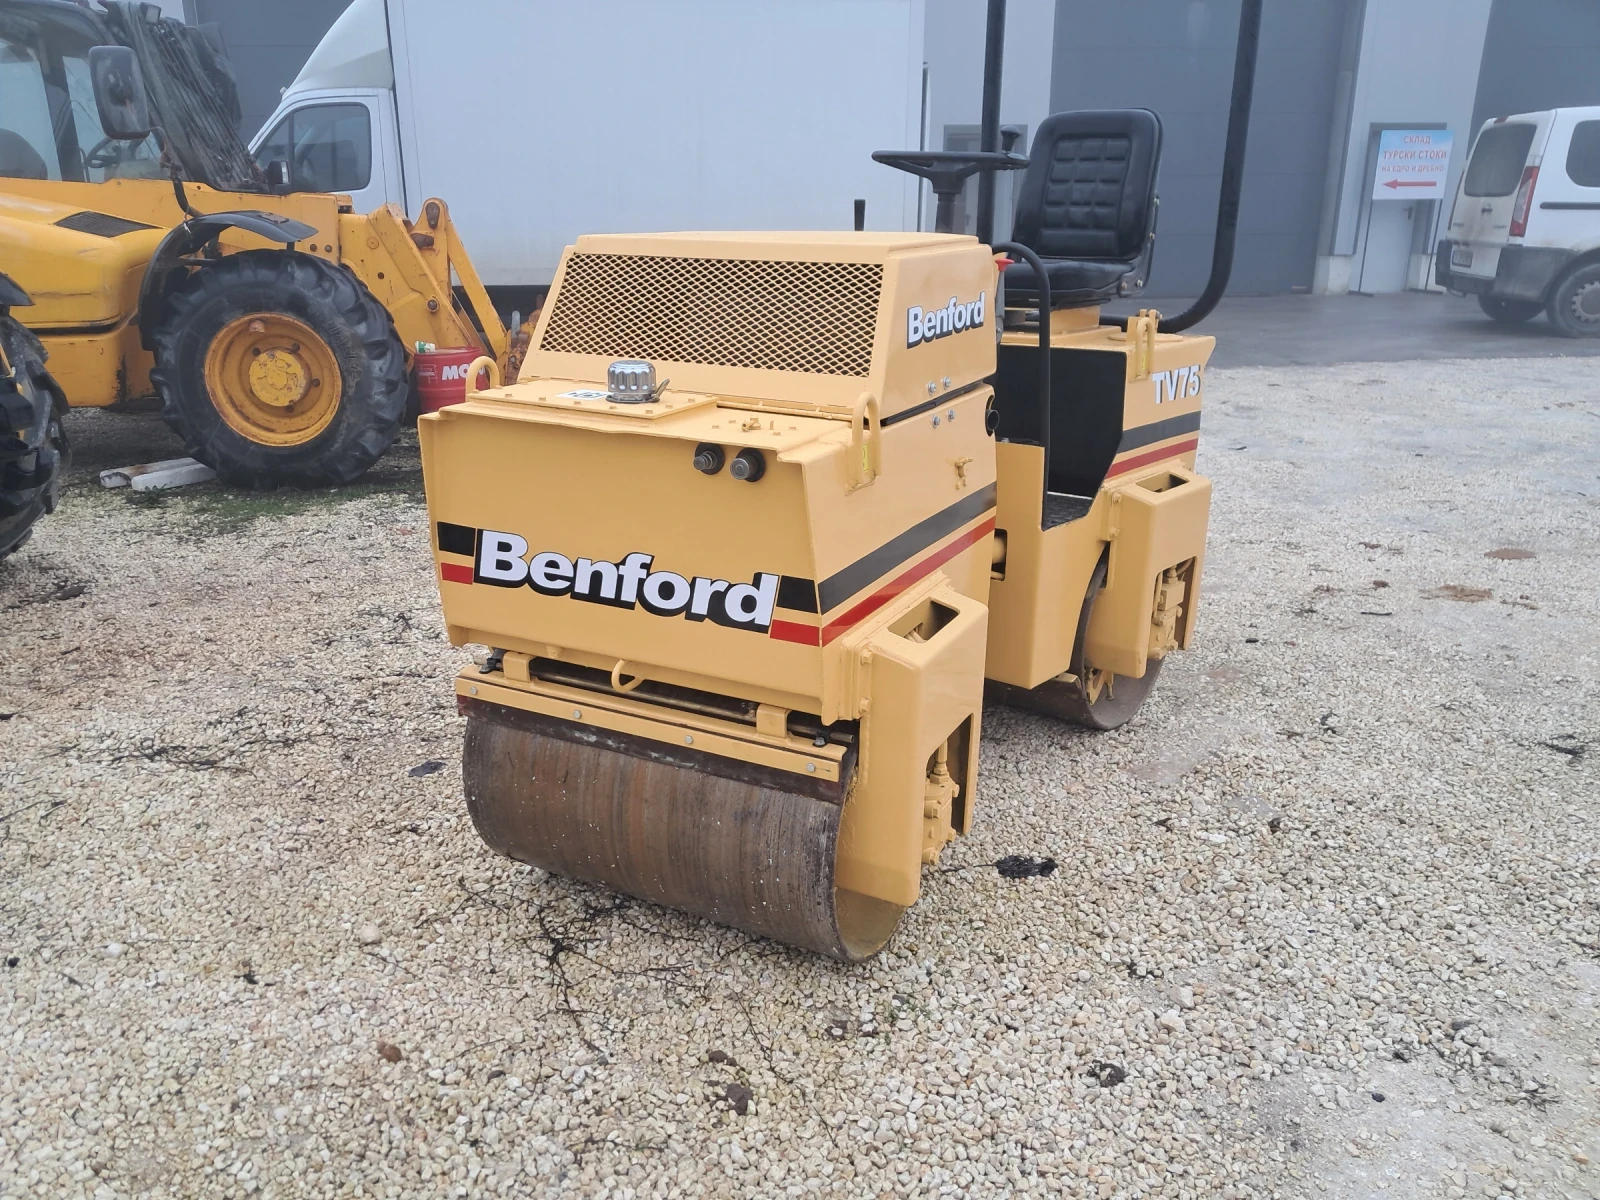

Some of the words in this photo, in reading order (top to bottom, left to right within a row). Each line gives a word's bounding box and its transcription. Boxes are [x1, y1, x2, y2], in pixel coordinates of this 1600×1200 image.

[1383, 150, 1416, 160] ТУРСКИ
[1418, 150, 1447, 159] СТОКИ
[1403, 135, 1431, 144] СКЛАД
[907, 291, 985, 349] Benford
[1152, 365, 1201, 404] TV75
[474, 528, 780, 634] Benford
